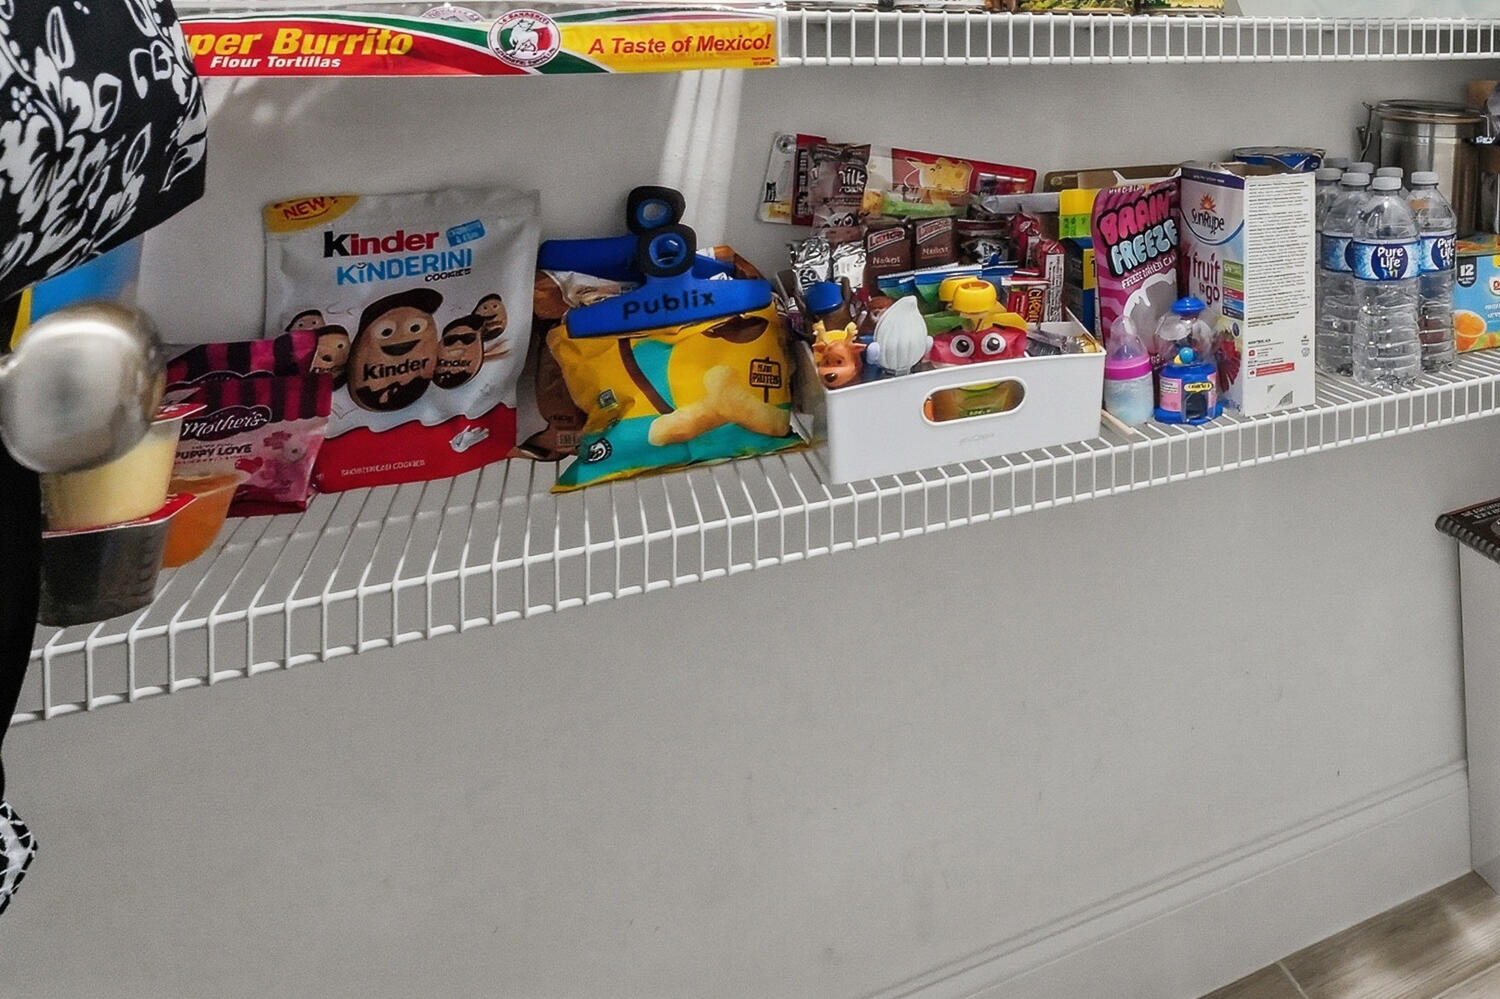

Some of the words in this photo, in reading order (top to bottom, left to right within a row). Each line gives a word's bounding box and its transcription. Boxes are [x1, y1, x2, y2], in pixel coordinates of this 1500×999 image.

[187, 32, 262, 57] per
[272, 28, 413, 55] Burrito
[588, 38, 604, 54] A
[612, 37, 665, 54] Taste
[675, 36, 694, 52] of
[697, 34, 772, 53] Mexico!
[210, 56, 261, 68] Flour
[267, 55, 341, 68] Tortillas
[1100, 195, 1171, 246] BRAIN
[323, 230, 439, 258] Kinder
[1111, 219, 1178, 275] FREEZE
[1377, 247, 1404, 260] Pure
[1193, 252, 1221, 283] fruit
[1380, 256, 1401, 269] Life
[1460, 265, 1474, 277] 12
[425, 268, 471, 282] COOKIES
[1206, 286, 1221, 305] go
[362, 357, 429, 381] Kinder
[218, 445, 253, 456] LOVE
